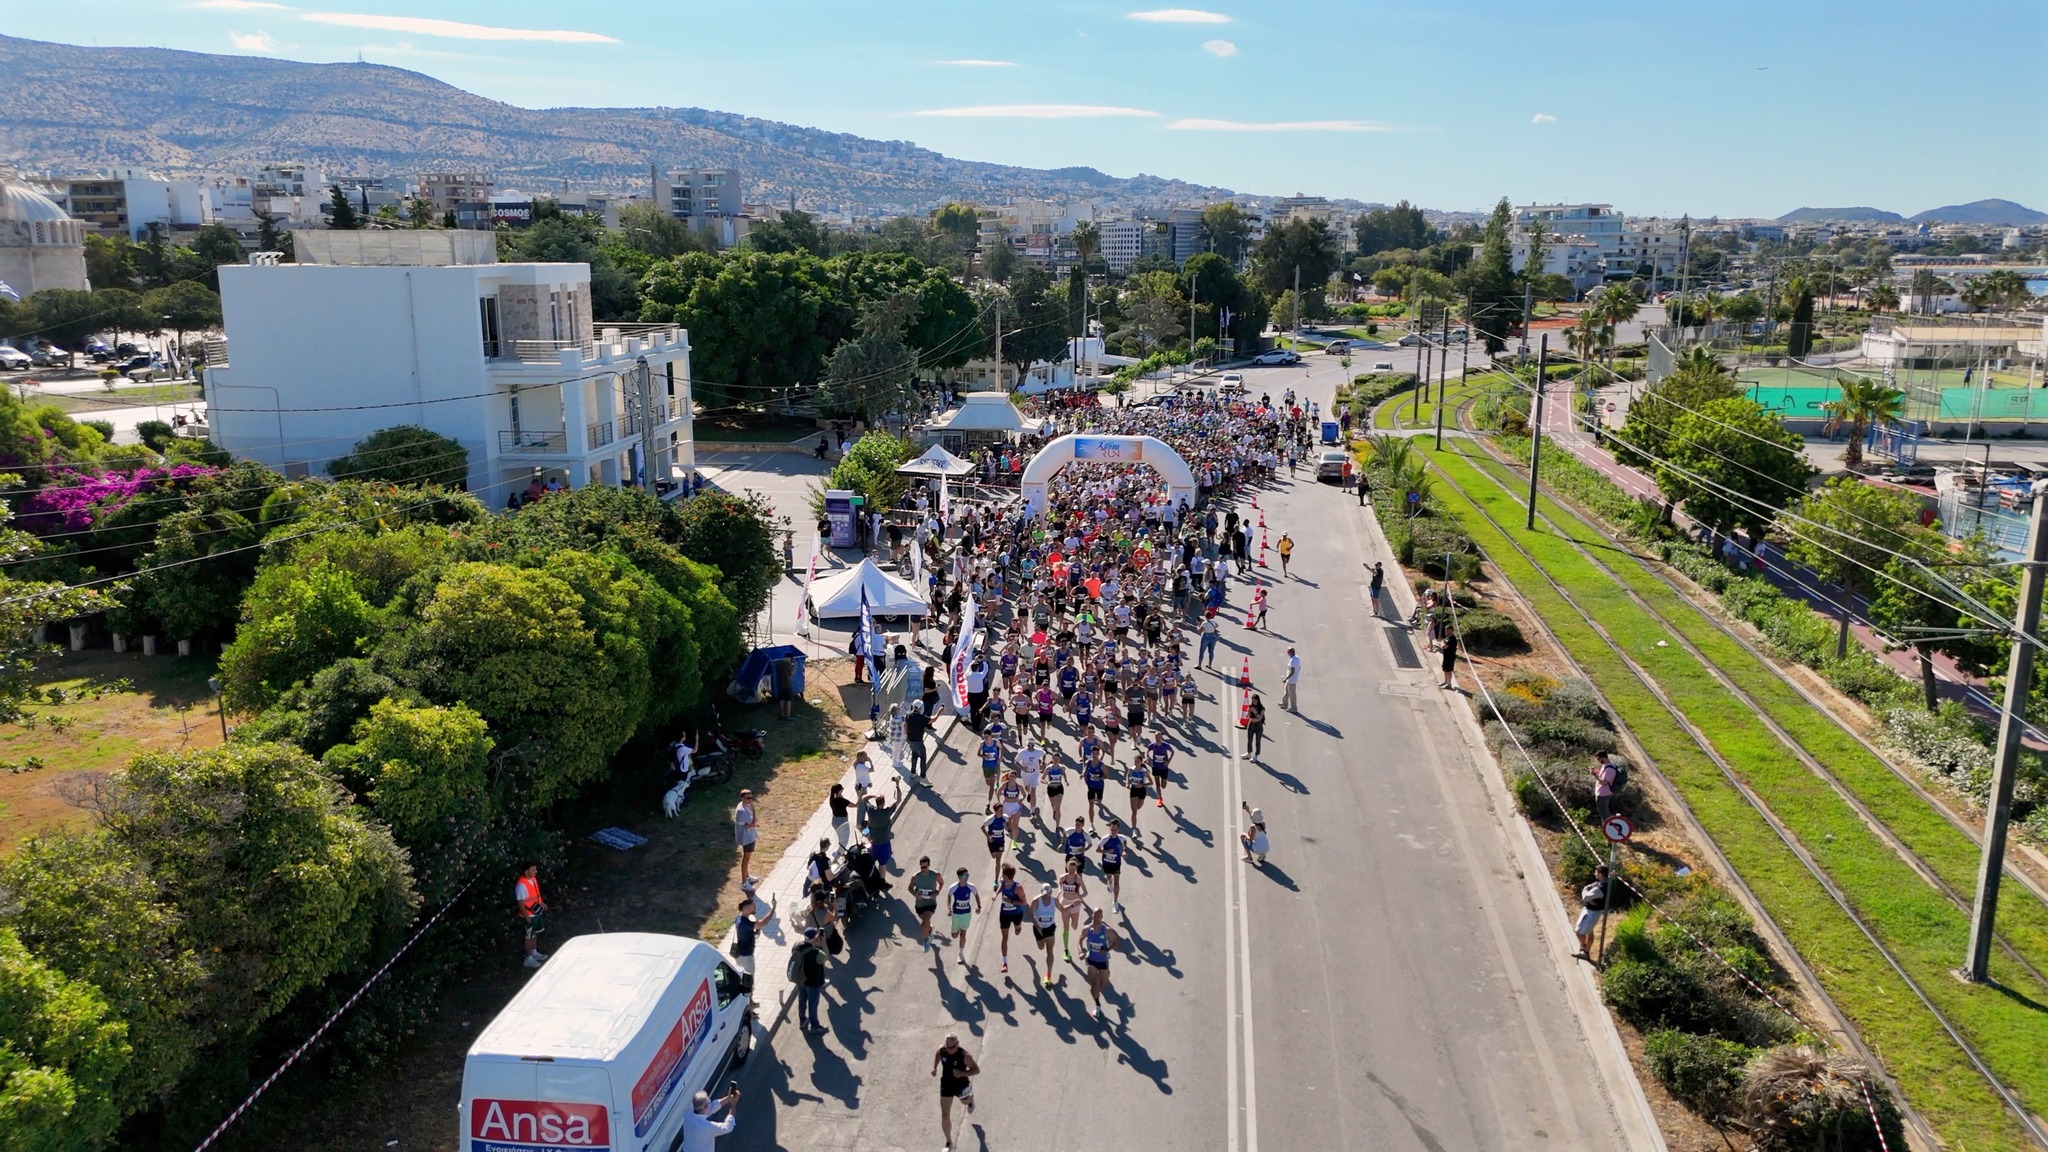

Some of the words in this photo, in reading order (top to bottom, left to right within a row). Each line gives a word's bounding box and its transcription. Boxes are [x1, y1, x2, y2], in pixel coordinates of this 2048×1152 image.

[491, 208, 530, 217] COSMOS
[1100, 449, 1120, 457] RUN
[681, 990, 708, 1050] Ansa
[480, 1101, 592, 1144] Ansa
